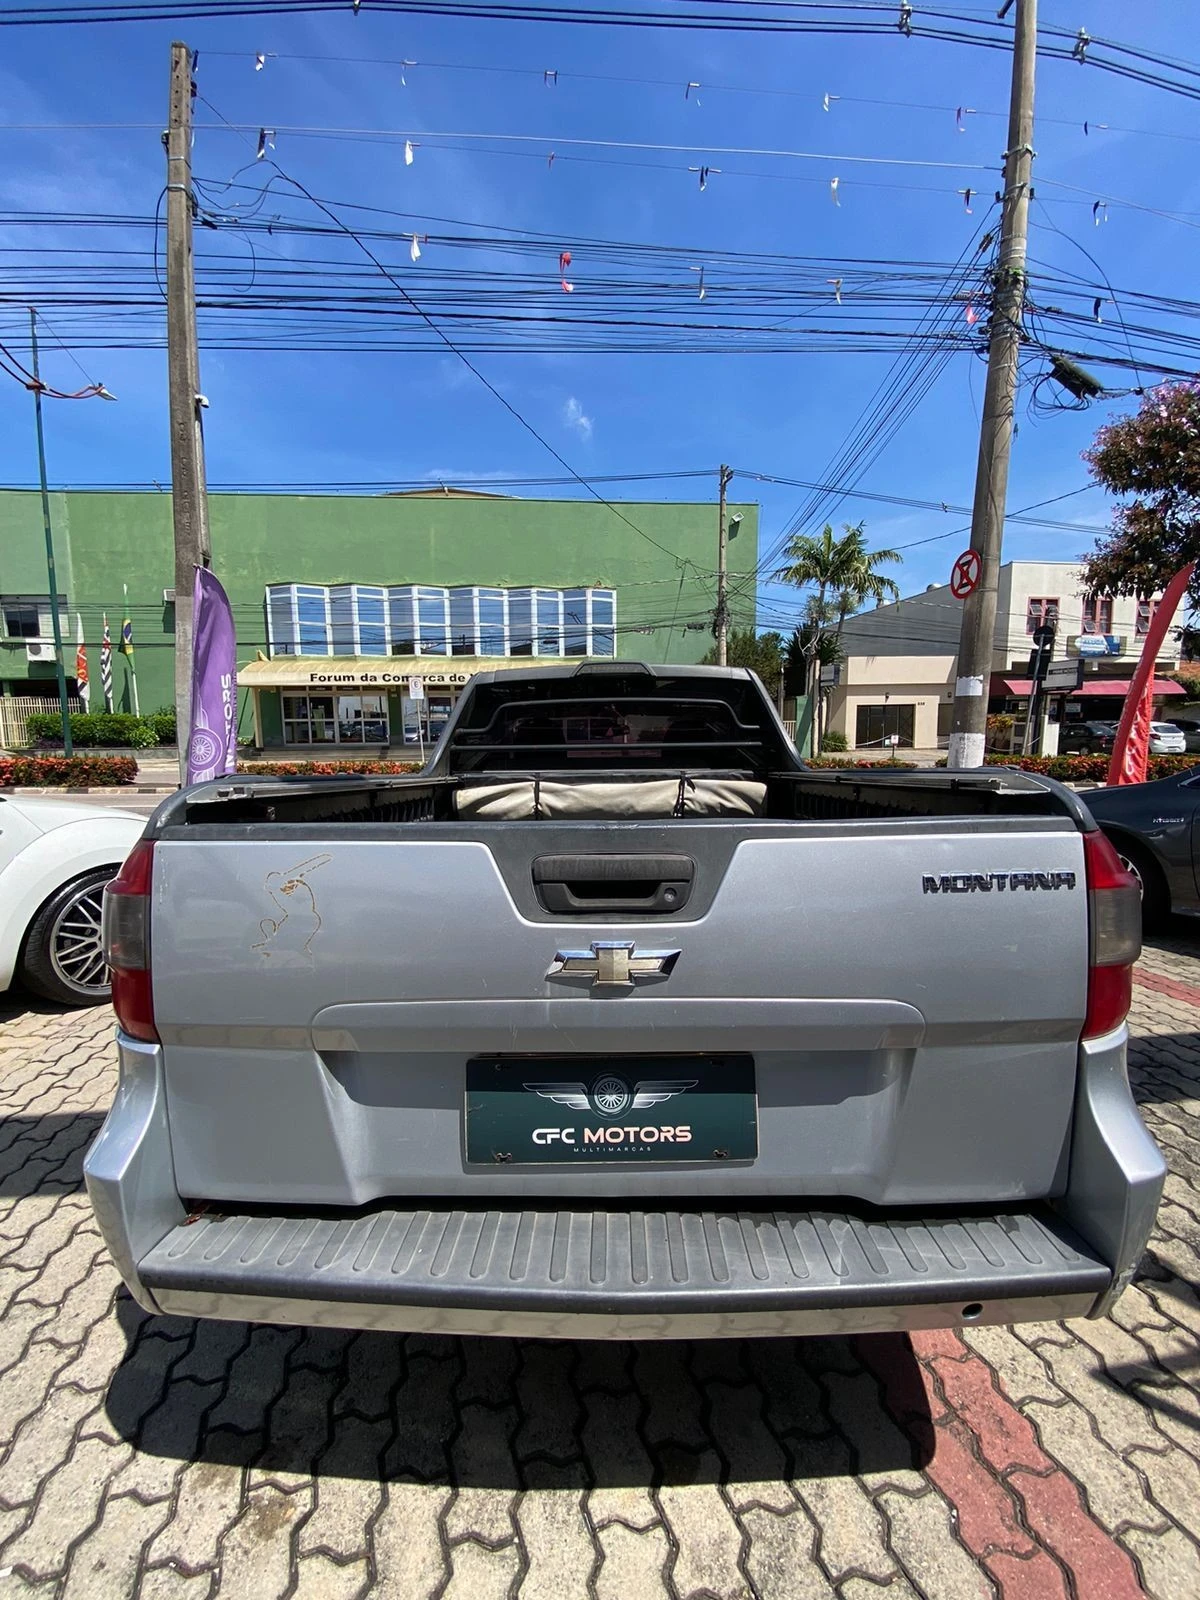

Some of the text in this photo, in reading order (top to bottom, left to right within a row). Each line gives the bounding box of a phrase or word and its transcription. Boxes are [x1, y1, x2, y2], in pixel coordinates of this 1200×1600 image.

[310, 673, 355, 682] Forum
[360, 673, 377, 682] da
[382, 673, 445, 682] Comrca
[449, 673, 466, 682] de
[922, 868, 1077, 894] MONTANA
[532, 1125, 693, 1145] CFC MOTORS
